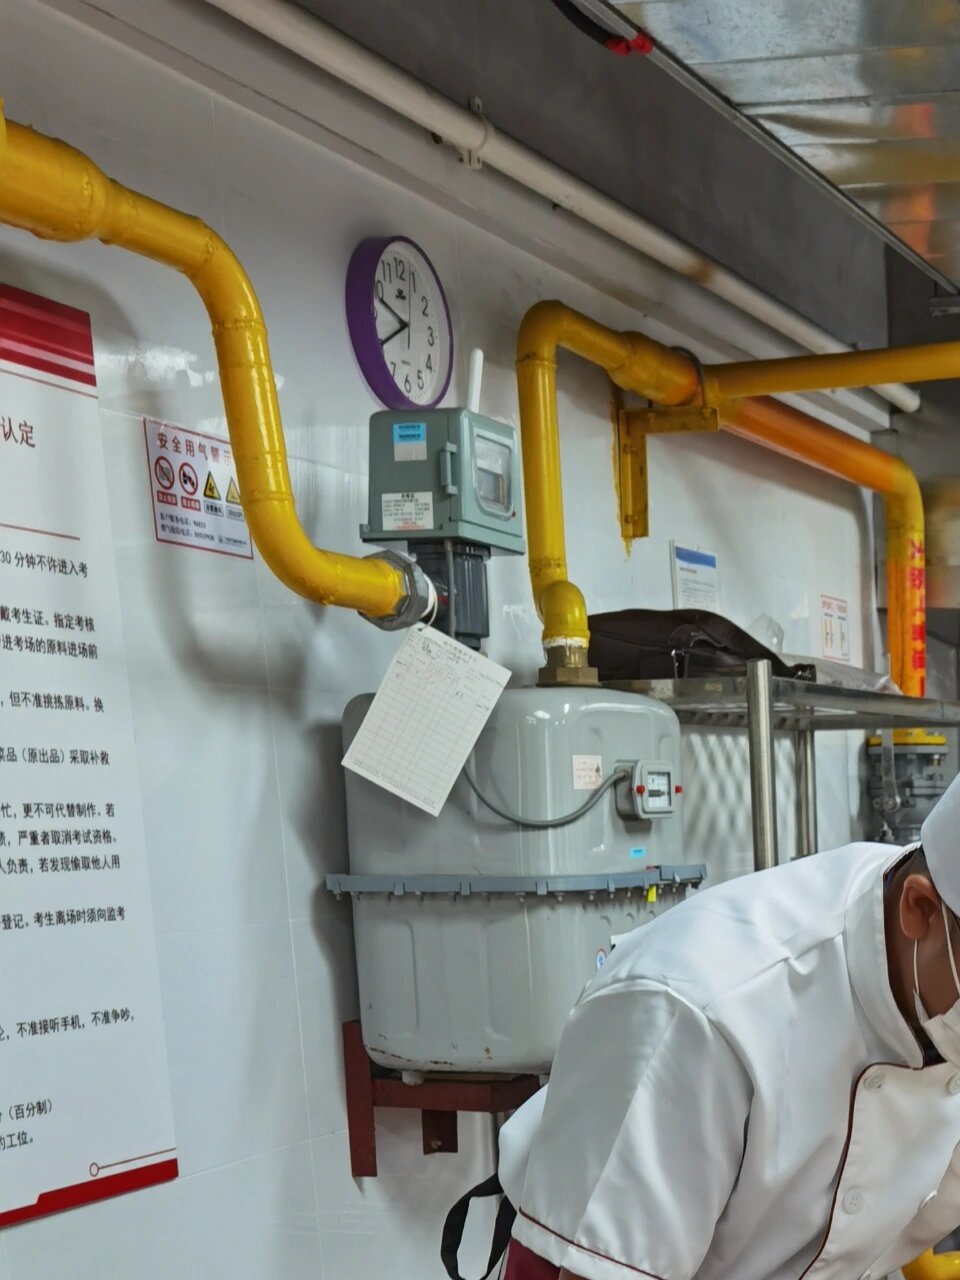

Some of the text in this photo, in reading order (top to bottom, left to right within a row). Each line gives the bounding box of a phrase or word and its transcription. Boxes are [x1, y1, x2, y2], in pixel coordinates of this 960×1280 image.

[380, 258, 393, 285] 11
[393, 256, 407, 282] 12
[375, 279, 385, 300] 0
[411, 271, 417, 294] 1
[421, 295, 429, 318] 2
[427, 325, 435, 348] 3
[390, 360, 397, 380] 7
[425, 353, 433, 373] 4
[404, 373, 412, 394] 6
[416, 369, 425, 391] 5
[0, 415, 36, 449] 认定
[0, 1098, 53, 1122] （百分制）
